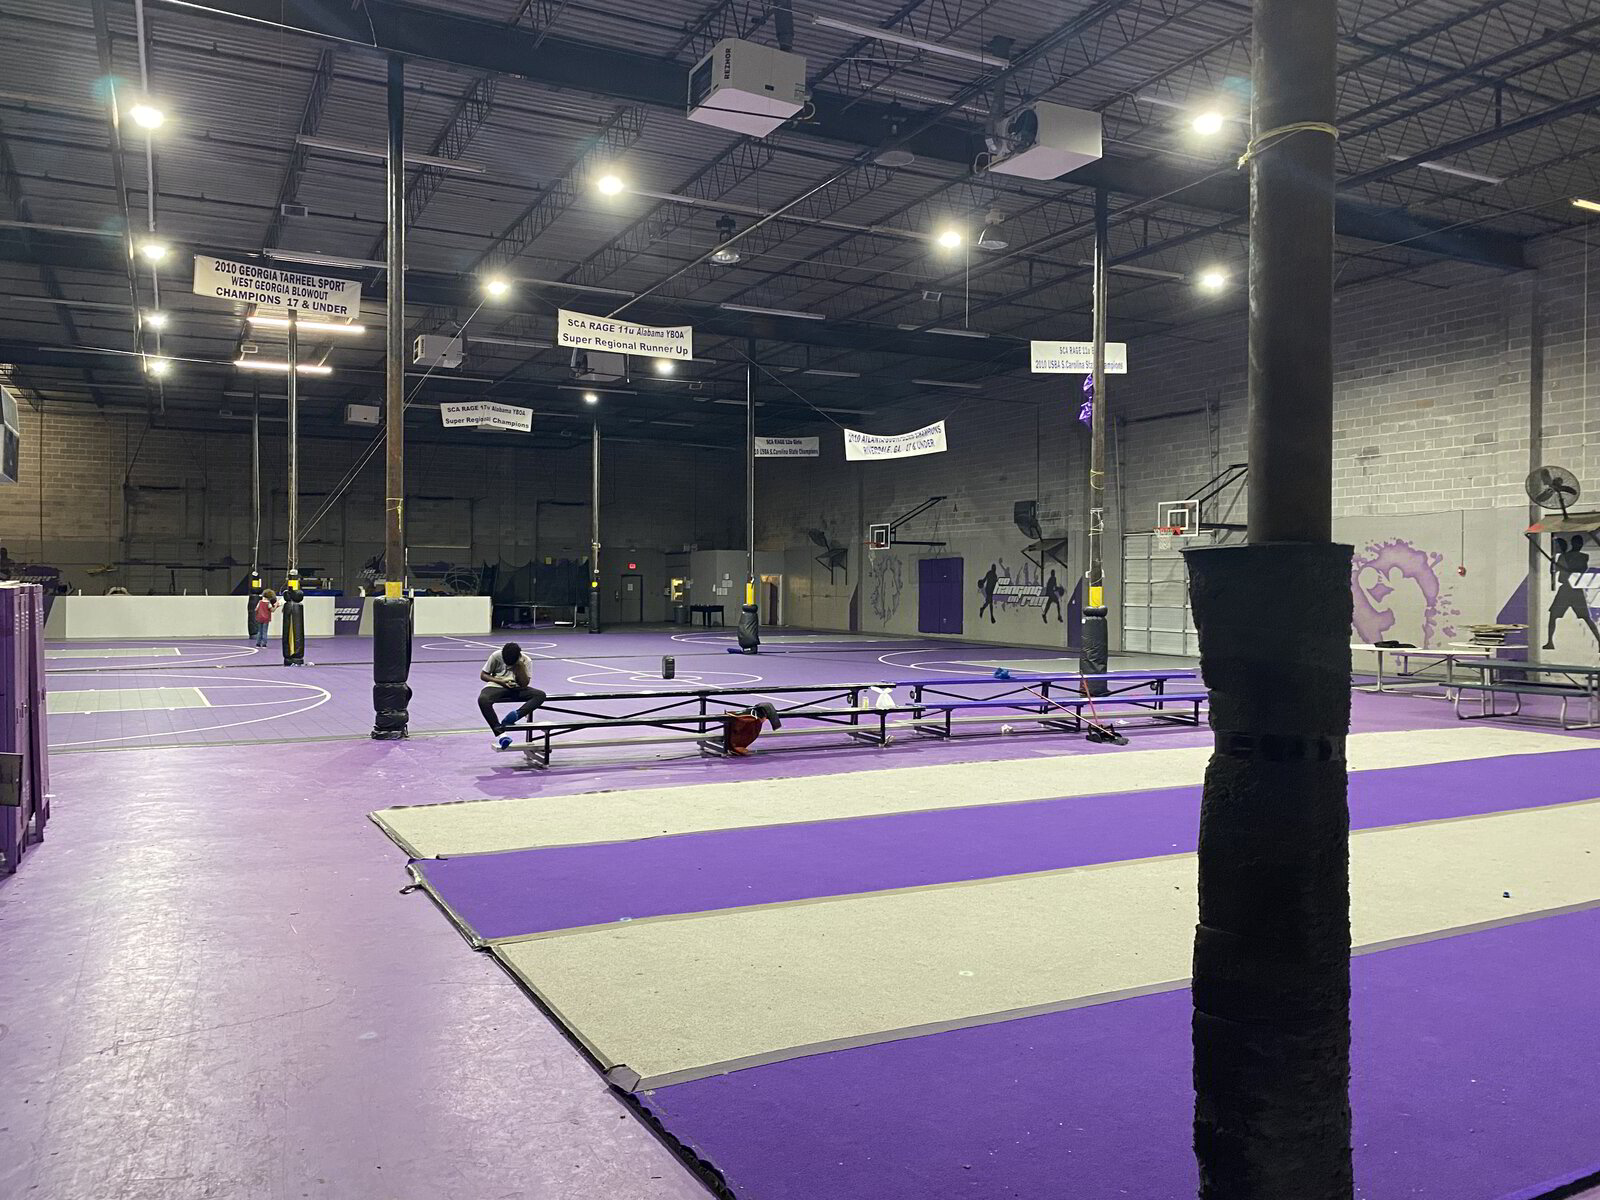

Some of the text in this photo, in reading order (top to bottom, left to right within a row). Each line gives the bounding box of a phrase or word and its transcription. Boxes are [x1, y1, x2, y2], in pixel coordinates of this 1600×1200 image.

[215, 260, 346, 292] 2010 GEORGIA TARHEEL SPORT
[231, 275, 328, 300] WEST GEORGIA BLOWOUT
[216, 287, 347, 315] CHAMPIONS 17 & UNDER
[567, 318, 684, 339] SCA RAGE 11u Alabama YBOA
[562, 332, 689, 356] Super Regional Runner Up
[492, 417, 529, 429] Champions
